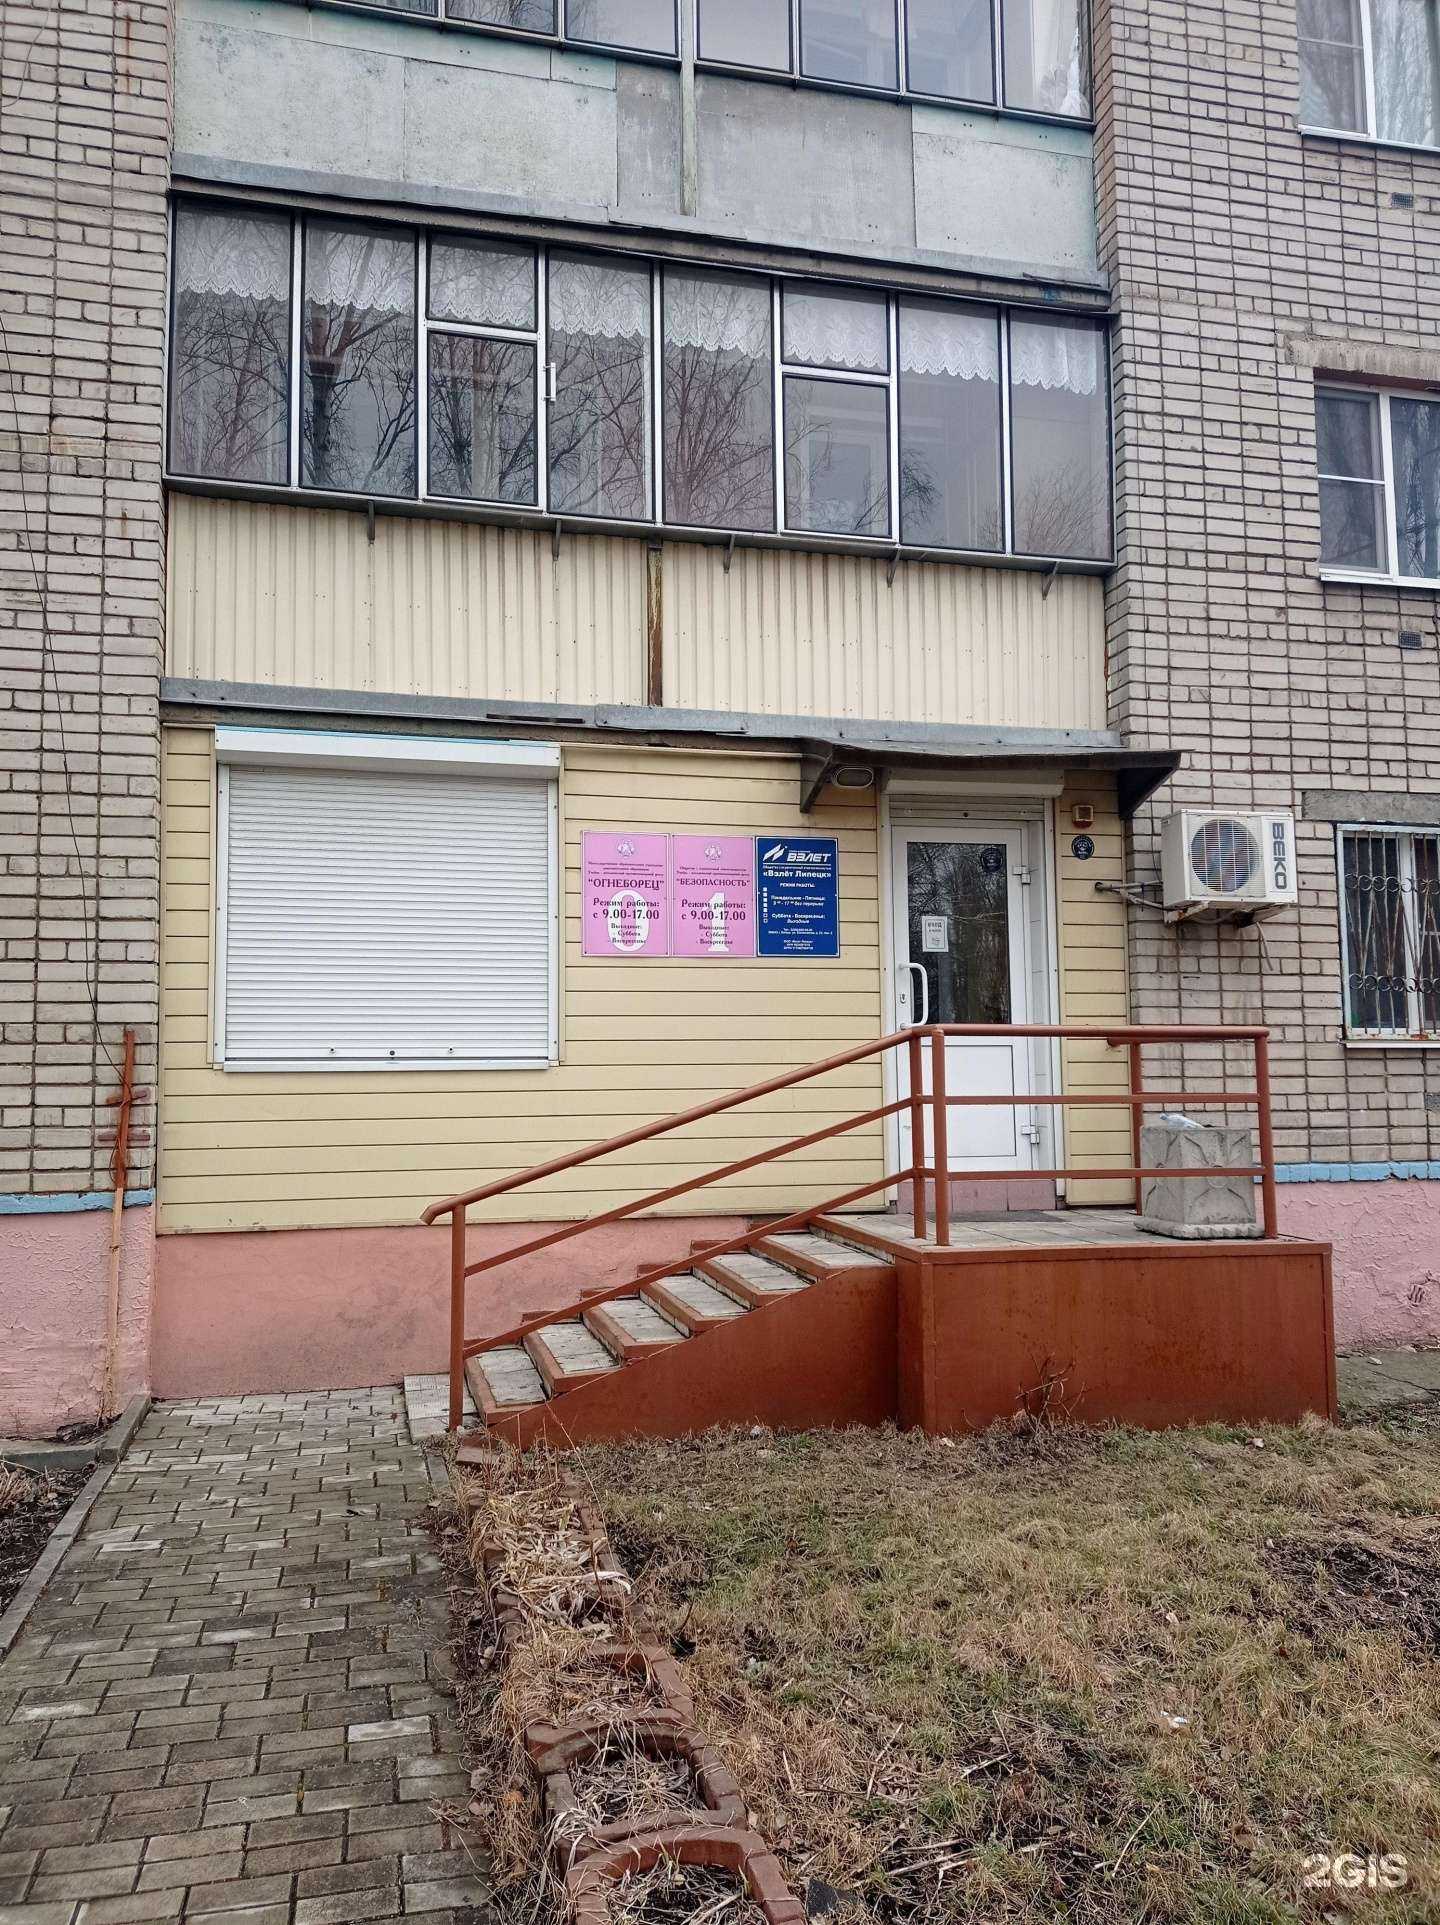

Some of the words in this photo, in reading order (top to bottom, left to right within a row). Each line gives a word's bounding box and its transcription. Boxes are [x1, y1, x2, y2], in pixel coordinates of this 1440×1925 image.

[787, 853, 831, 862] ВЗЛЕТ
[1272, 823, 1287, 889] BEKO
[795, 871, 831, 879] Липецк»
[593, 897, 623, 907] Режим
[627, 899, 660, 909] работы:
[681, 898, 711, 908] Режим
[713, 900, 746, 910] работы:
[602, 909, 660, 919] 9.00-17.00
[690, 910, 746, 920] 9.00-17.00
[617, 930, 641, 938] Суббота
